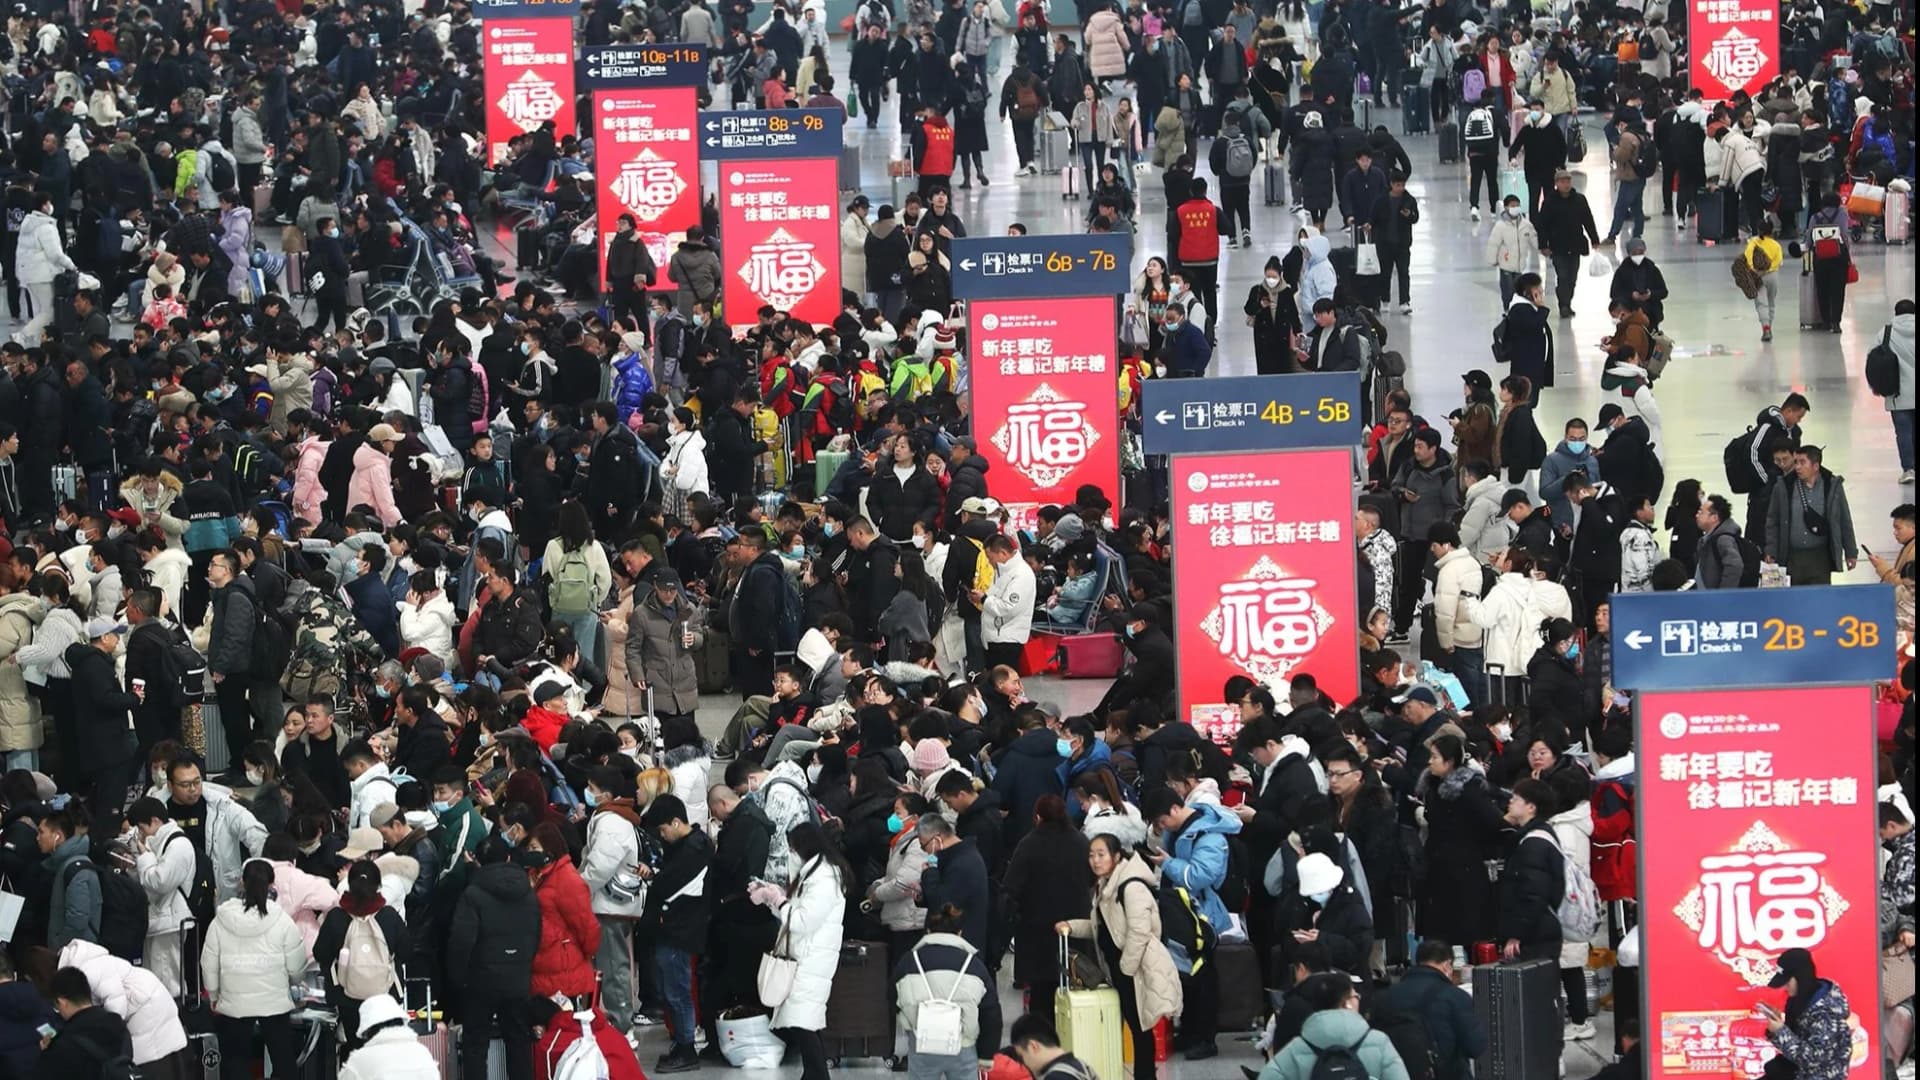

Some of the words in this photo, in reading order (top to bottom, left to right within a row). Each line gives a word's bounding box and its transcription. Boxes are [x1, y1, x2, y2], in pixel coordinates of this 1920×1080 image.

[1711, 38, 1760, 79] 福
[506, 82, 556, 120] 福
[769, 116, 788, 131] 8B
[803, 115, 823, 131] 9B
[620, 161, 677, 207] 福
[730, 191, 788, 207] 新年要吃
[745, 205, 830, 222] 徐福记新年糖
[750, 243, 815, 296] 福
[1007, 253, 1043, 266] 检票口
[1046, 251, 1073, 272] 6B
[1089, 250, 1116, 271] 7B
[982, 338, 1053, 357] 新年要吃
[1000, 355, 1105, 375] 徐福记新年糖
[1213, 402, 1257, 417] 检票口
[1260, 400, 1293, 424] 4B
[1317, 397, 1350, 422] 5B
[1213, 419, 1237, 428] Check
[1238, 419, 1245, 427] in
[1006, 402, 1087, 468] 福
[1188, 500, 1275, 525] 新年要吃
[1210, 521, 1340, 547] 徐福记新年糖
[1218, 579, 1318, 660] 福
[1700, 621, 1758, 641] 检票口
[1763, 618, 1805, 650] 2B
[1837, 615, 1880, 648] 3B
[1700, 643, 1732, 654] Check
[1733, 642, 1742, 652] in
[1660, 751, 1773, 781] 新年要吃
[1688, 777, 1857, 809] 徐福记新年糖
[1698, 851, 1827, 956] 福
